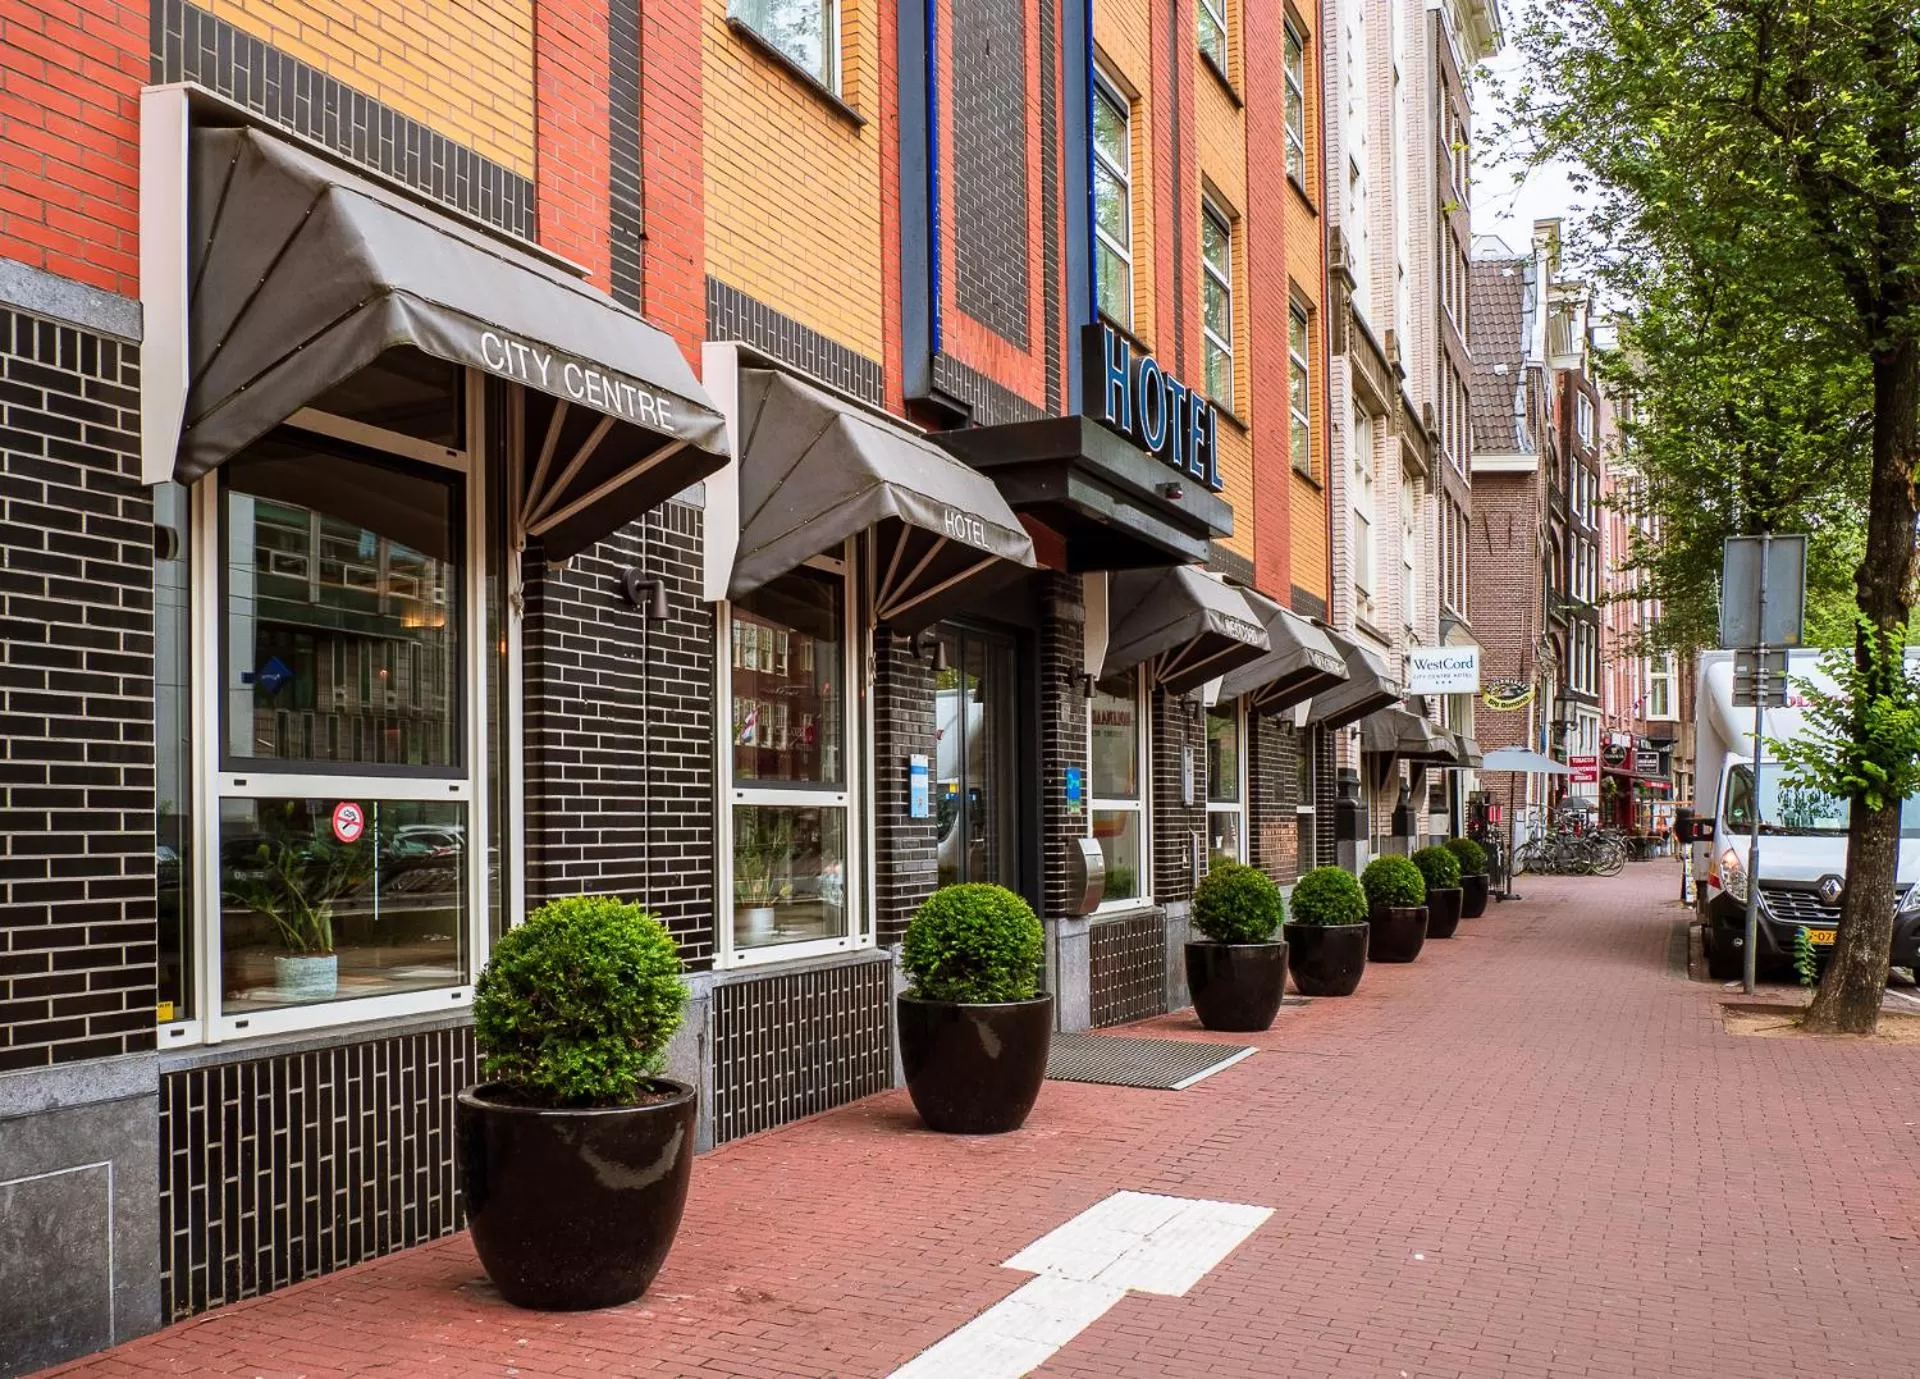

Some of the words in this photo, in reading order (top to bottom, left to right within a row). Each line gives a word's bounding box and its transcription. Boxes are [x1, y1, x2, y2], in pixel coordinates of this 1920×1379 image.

[481, 332, 551, 386] CITY
[564, 363, 674, 431] CENTRE
[1104, 323, 1224, 491] HOTEL
[944, 508, 991, 549] HOTEL
[1414, 654, 1474, 670] WestCord
